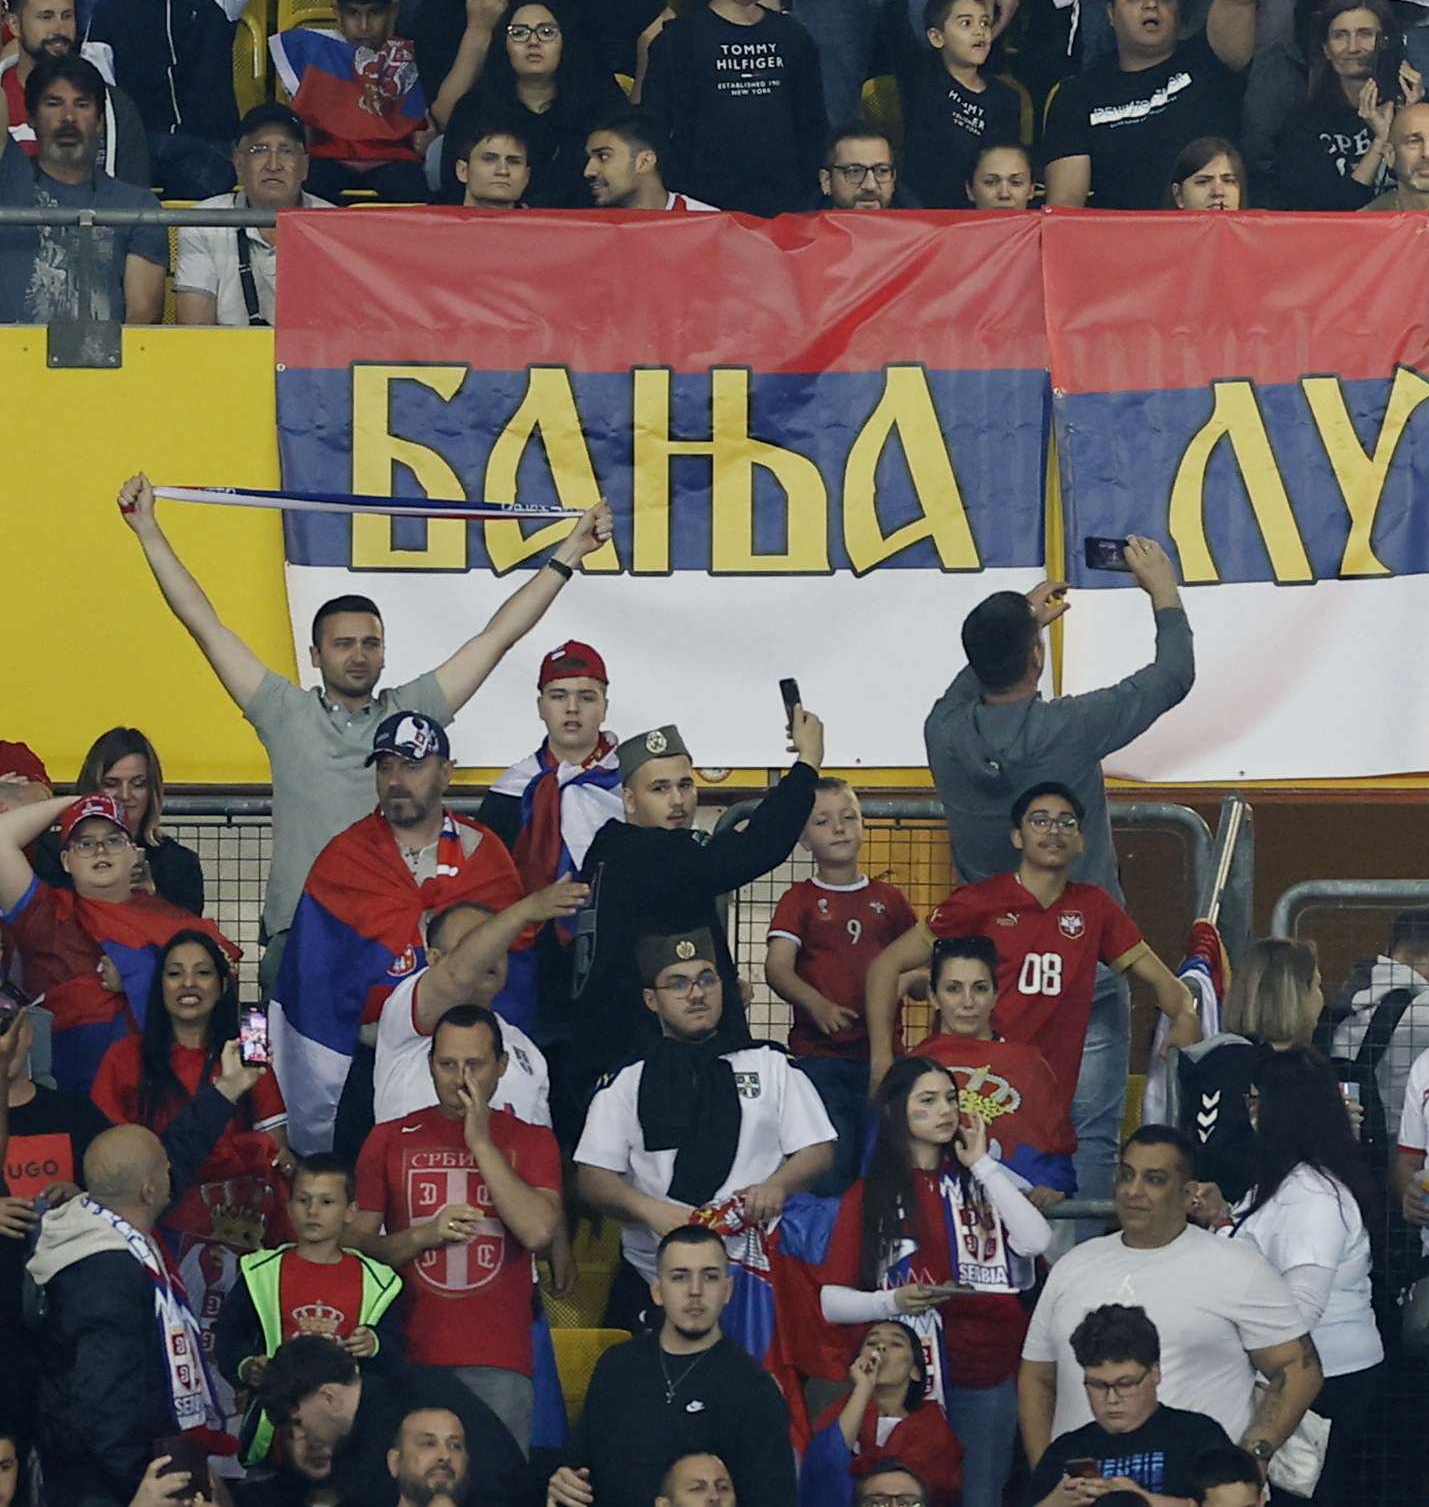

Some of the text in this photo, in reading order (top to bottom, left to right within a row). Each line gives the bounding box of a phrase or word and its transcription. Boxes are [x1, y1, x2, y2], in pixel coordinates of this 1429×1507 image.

[720, 42, 778, 57] TOMMY
[716, 55, 785, 71] HILFIGER
[349, 360, 982, 577] БАЊА
[847, 919, 862, 944] 9
[1018, 952, 1062, 996] 08
[410, 1151, 475, 1168] СРБИ
[959, 1263, 1009, 1285] SERBIA
